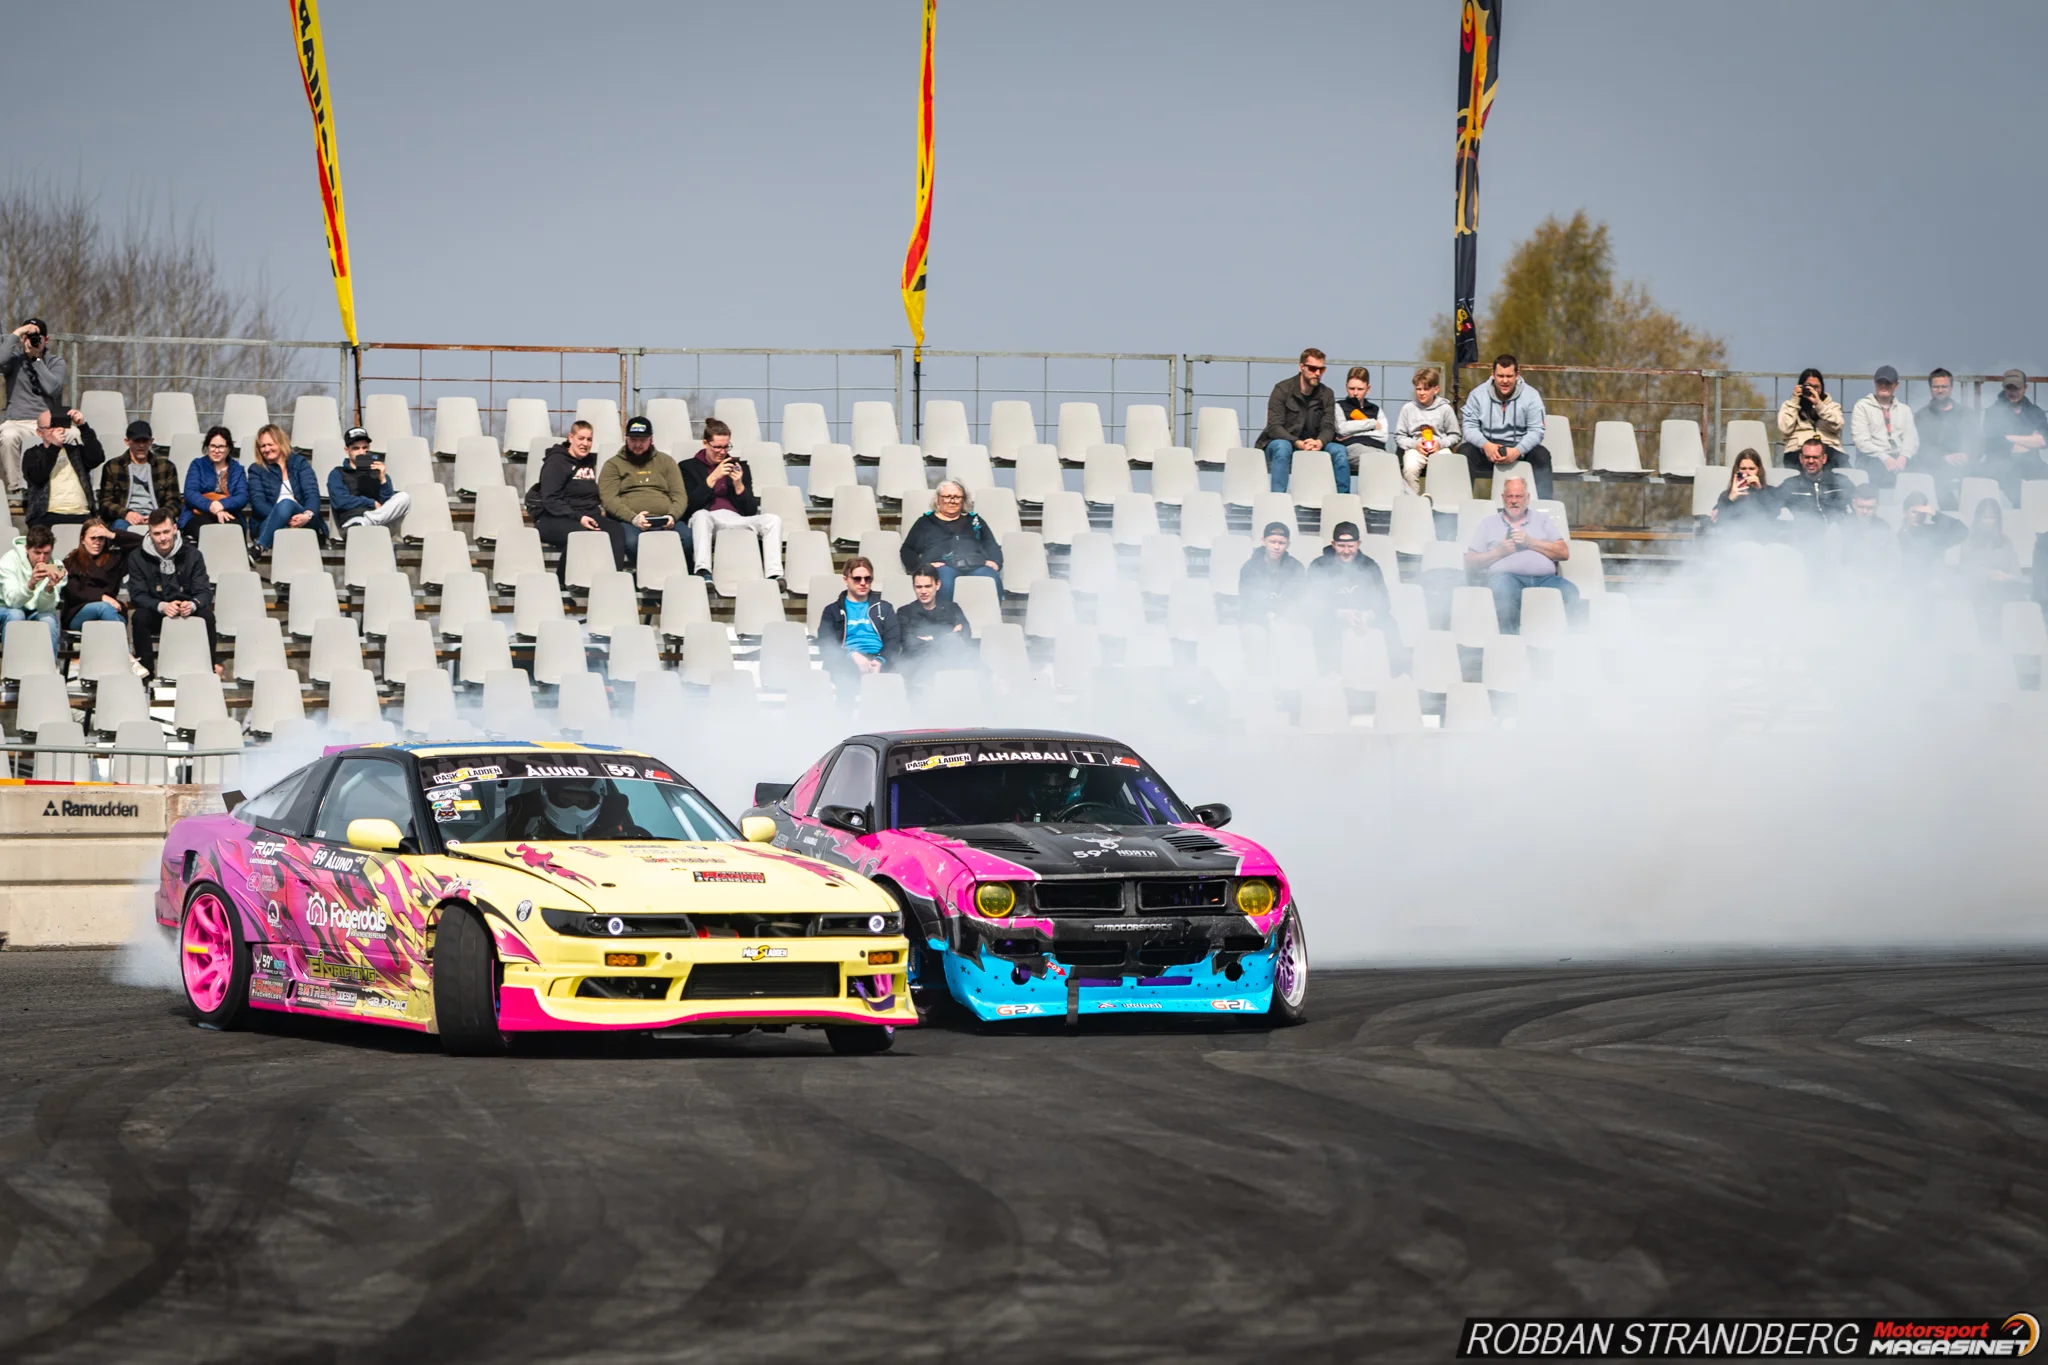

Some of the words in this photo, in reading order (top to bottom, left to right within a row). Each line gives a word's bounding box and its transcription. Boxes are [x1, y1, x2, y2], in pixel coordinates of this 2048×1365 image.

[978, 752, 1068, 763] ALHARBALI
[1083, 752, 1095, 763] 1
[525, 764, 589, 777] ÅLUND
[606, 765, 635, 777] 59
[61, 800, 139, 817] Ramudden
[312, 849, 328, 866] 59
[324, 851, 354, 872] ÅLUND
[330, 902, 387, 938] Fagerdals
[1047, 961, 1062, 974] TOW
